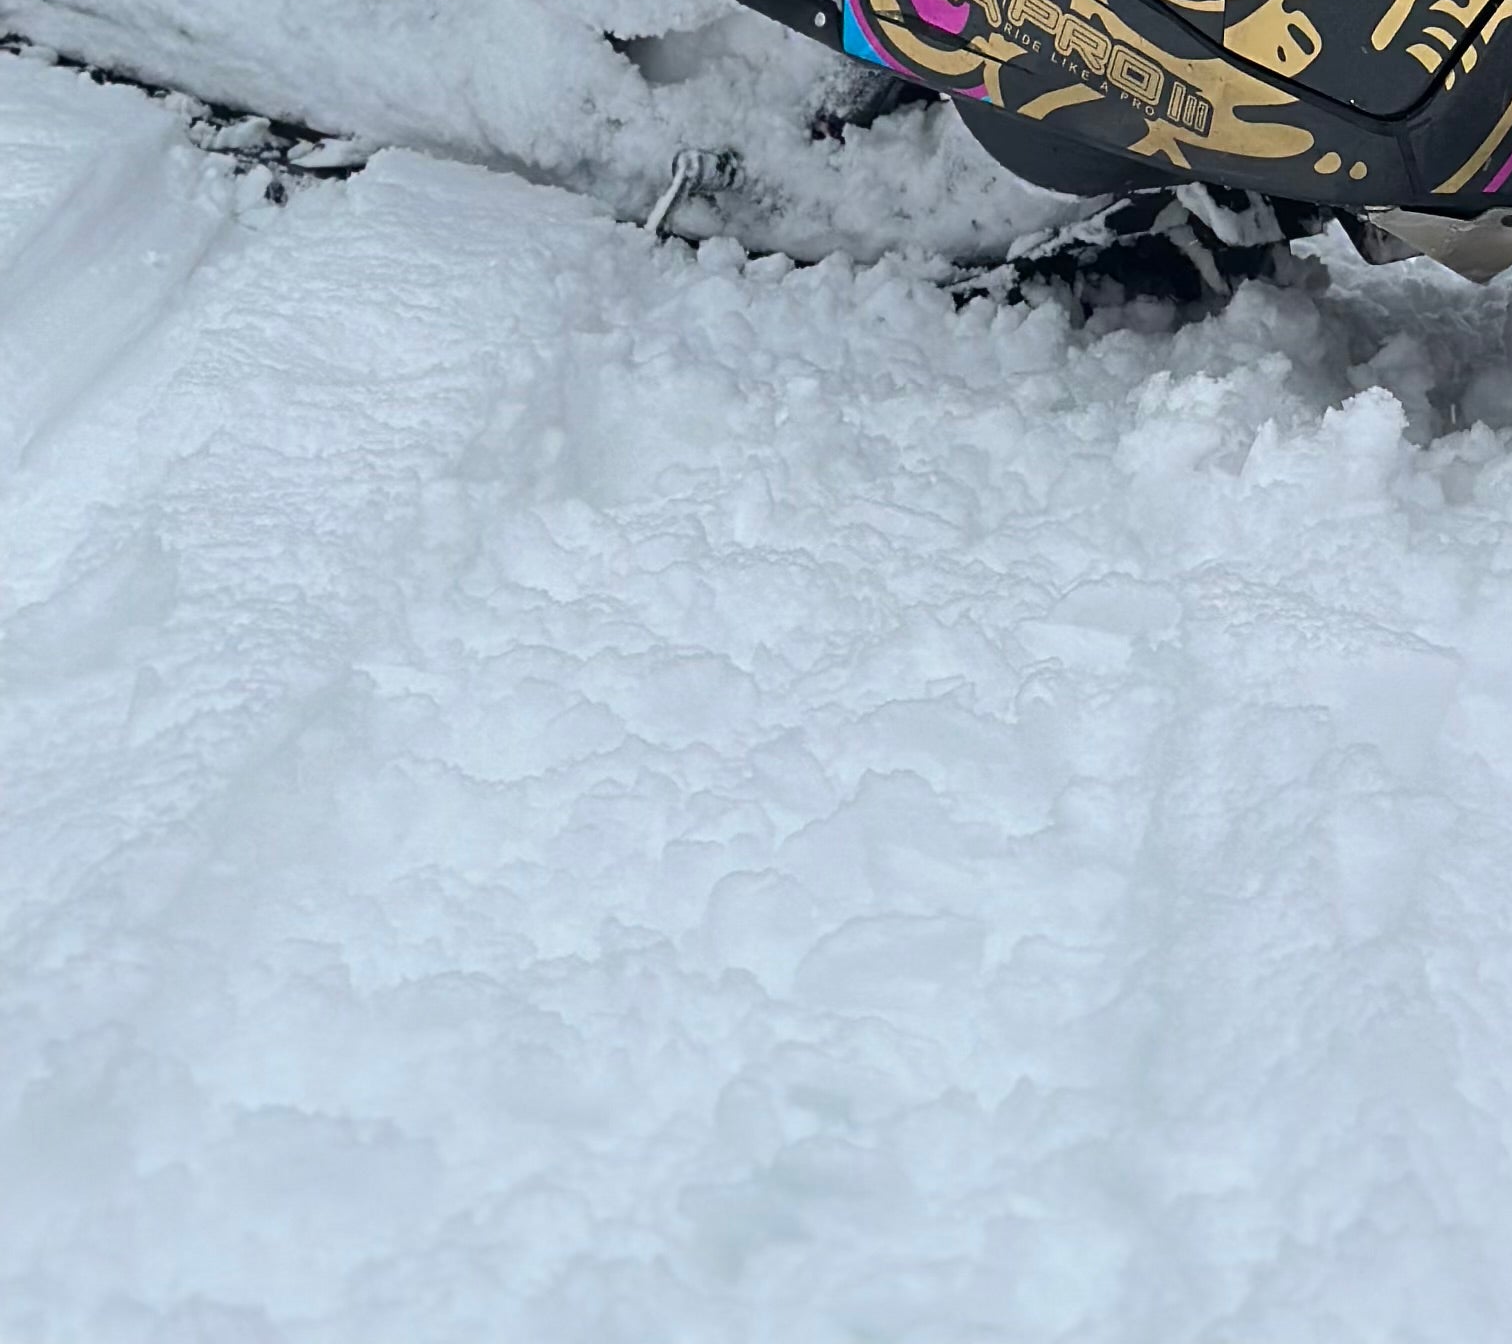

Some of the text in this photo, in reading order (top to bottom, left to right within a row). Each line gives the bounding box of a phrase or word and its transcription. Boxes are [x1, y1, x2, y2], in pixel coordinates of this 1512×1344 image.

[1003, 22, 1155, 116] RIDE LIKE A PRO
